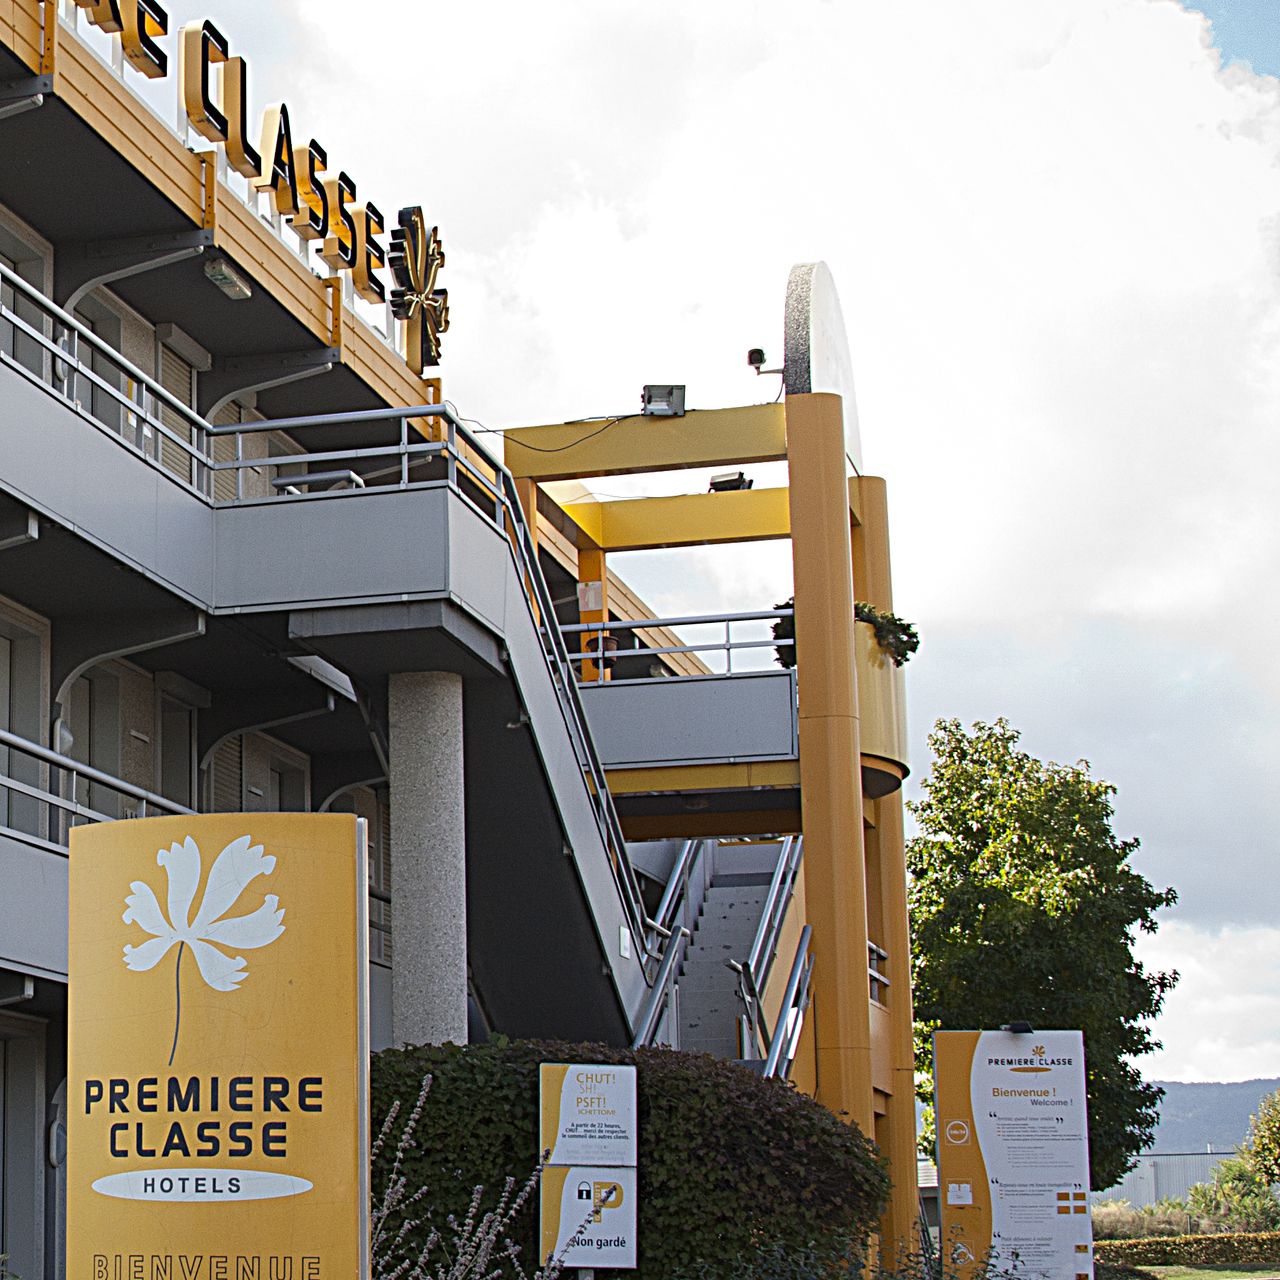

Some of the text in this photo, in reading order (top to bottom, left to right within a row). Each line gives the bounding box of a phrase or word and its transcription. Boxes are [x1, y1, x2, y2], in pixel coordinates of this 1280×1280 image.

[184, 18, 387, 306] CLASSE
[988, 1058, 1073, 1066] PREMIERE CLASSE
[576, 1072, 616, 1085] CHUT!
[85, 1076, 323, 1114] PREMIERE
[992, 1087, 1050, 1097] Bienvenue
[1030, 1099, 1069, 1107] Welcome
[109, 1121, 287, 1157] CLASSE
[144, 1177, 241, 1194] HOTELS
[596, 1236, 626, 1250] gardé
